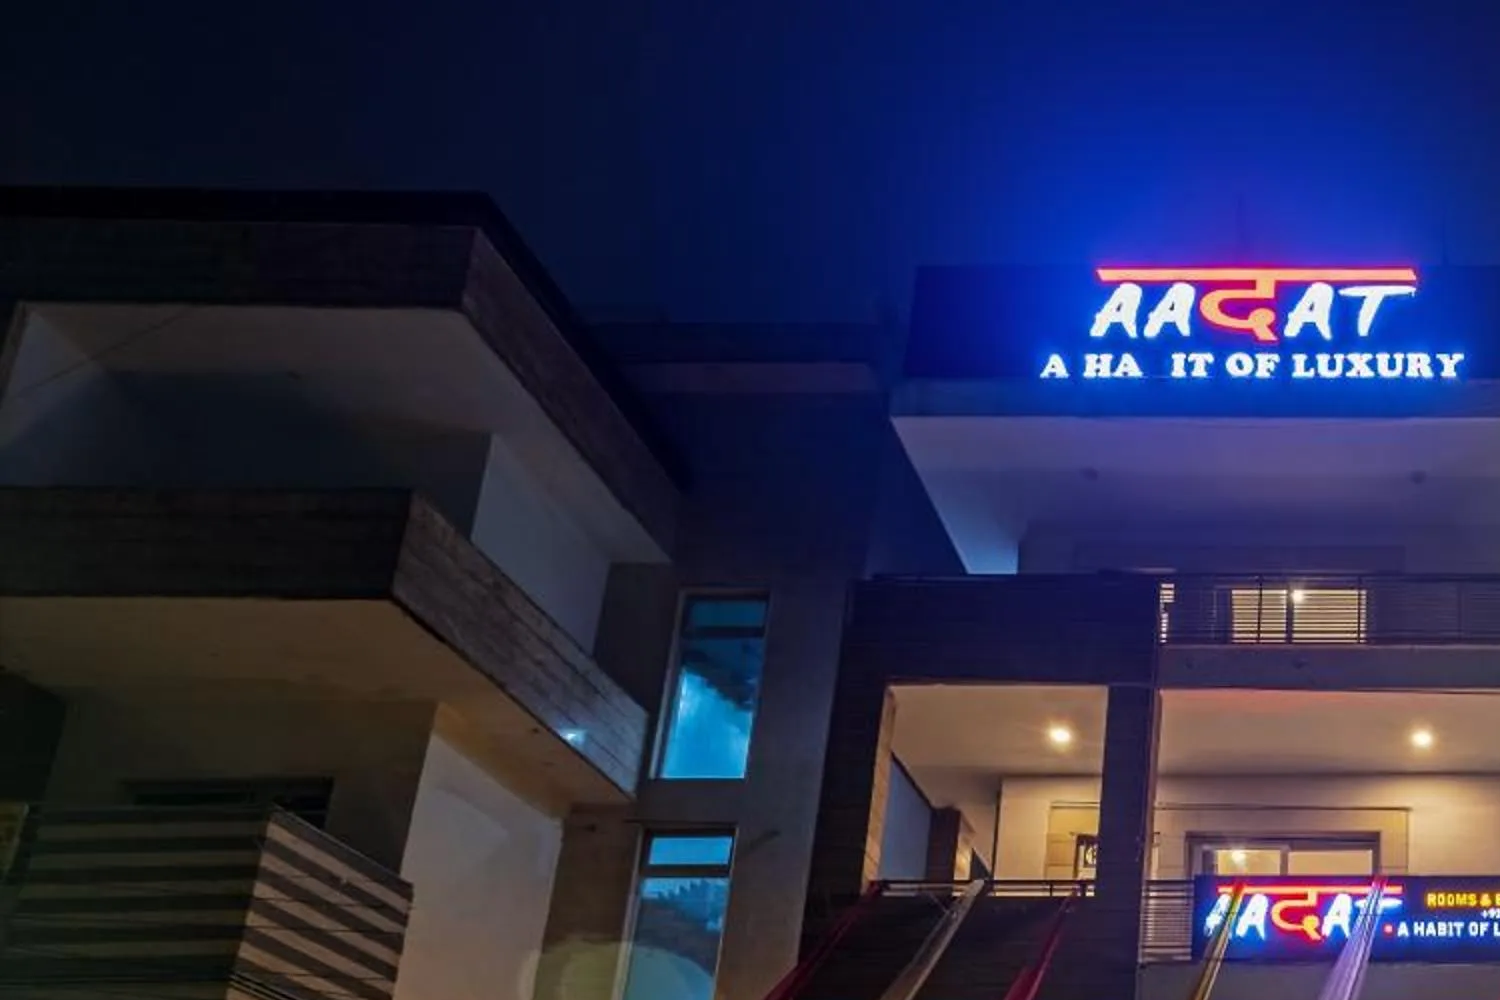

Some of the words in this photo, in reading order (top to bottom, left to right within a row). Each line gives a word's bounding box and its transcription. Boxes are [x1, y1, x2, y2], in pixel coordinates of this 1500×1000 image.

[1040, 354, 1069, 378] A
[1225, 353, 1280, 378] OF
[1291, 353, 1465, 378] LUXURY
[1427, 893, 1477, 907] ROOMS
[1398, 921, 1411, 937] A
[1413, 921, 1465, 937] HABIT
[1468, 921, 1489, 937] OF
